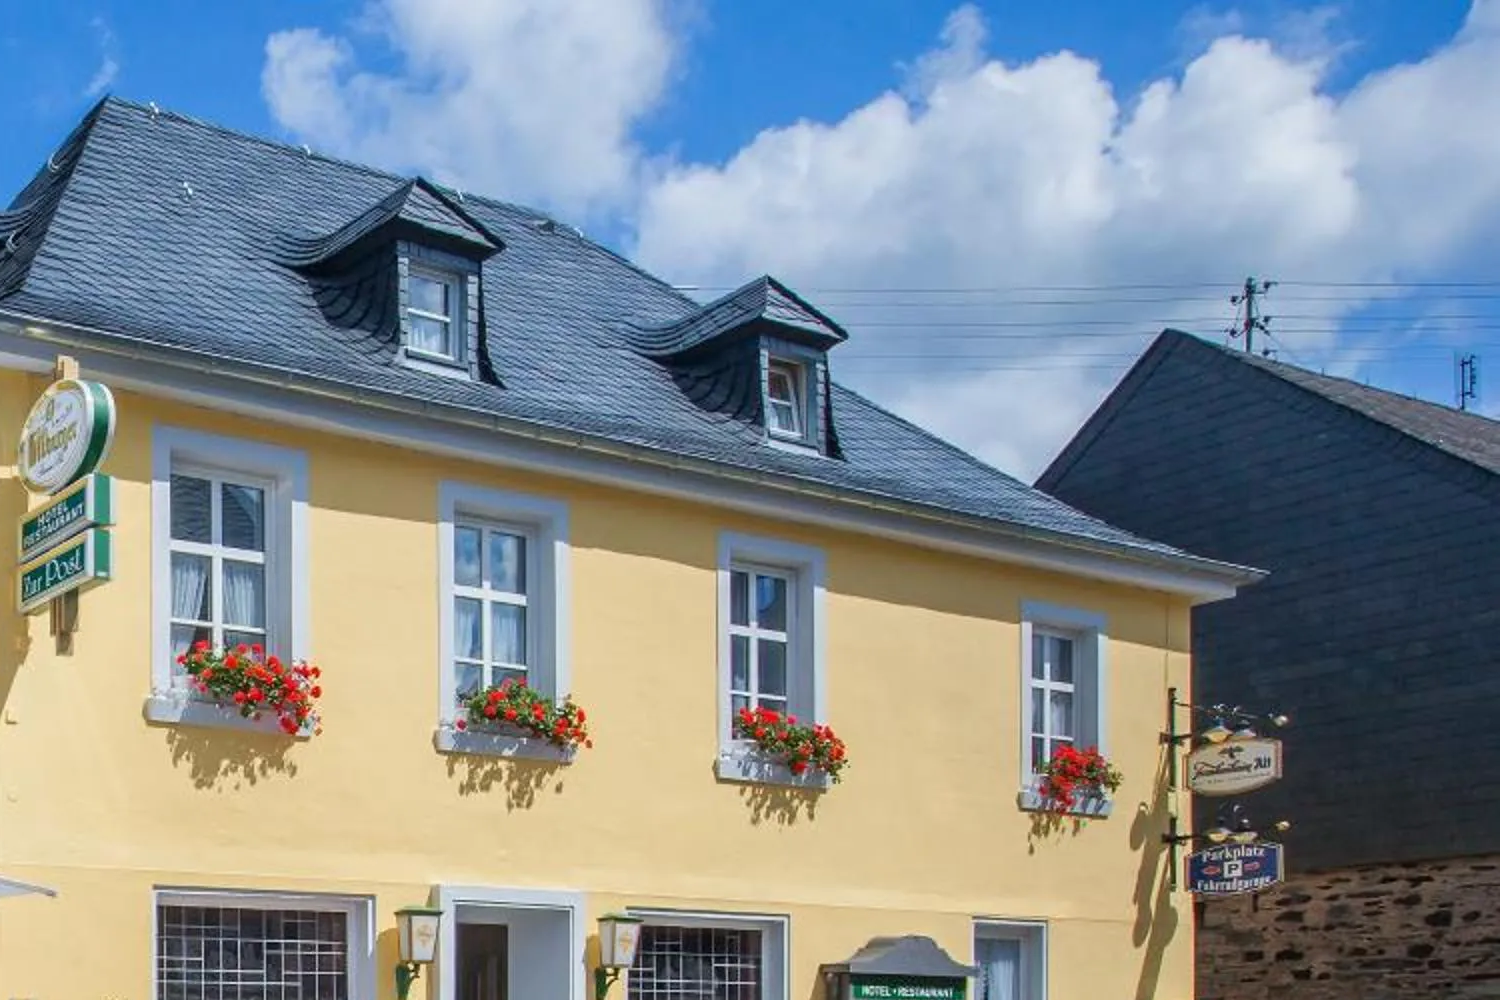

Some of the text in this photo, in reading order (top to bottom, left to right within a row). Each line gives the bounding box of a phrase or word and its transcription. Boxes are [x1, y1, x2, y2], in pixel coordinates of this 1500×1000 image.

[37, 500, 68, 526] HOTEL
[23, 503, 84, 549] RESTAURANT
[24, 547, 83, 597] Zur Post
[1202, 844, 1265, 863] Parkplatz
[1227, 863, 1240, 875] P
[1197, 876, 1275, 894] Fahrradgarage
[861, 985, 953, 998] HOTEL RESTAURANT
